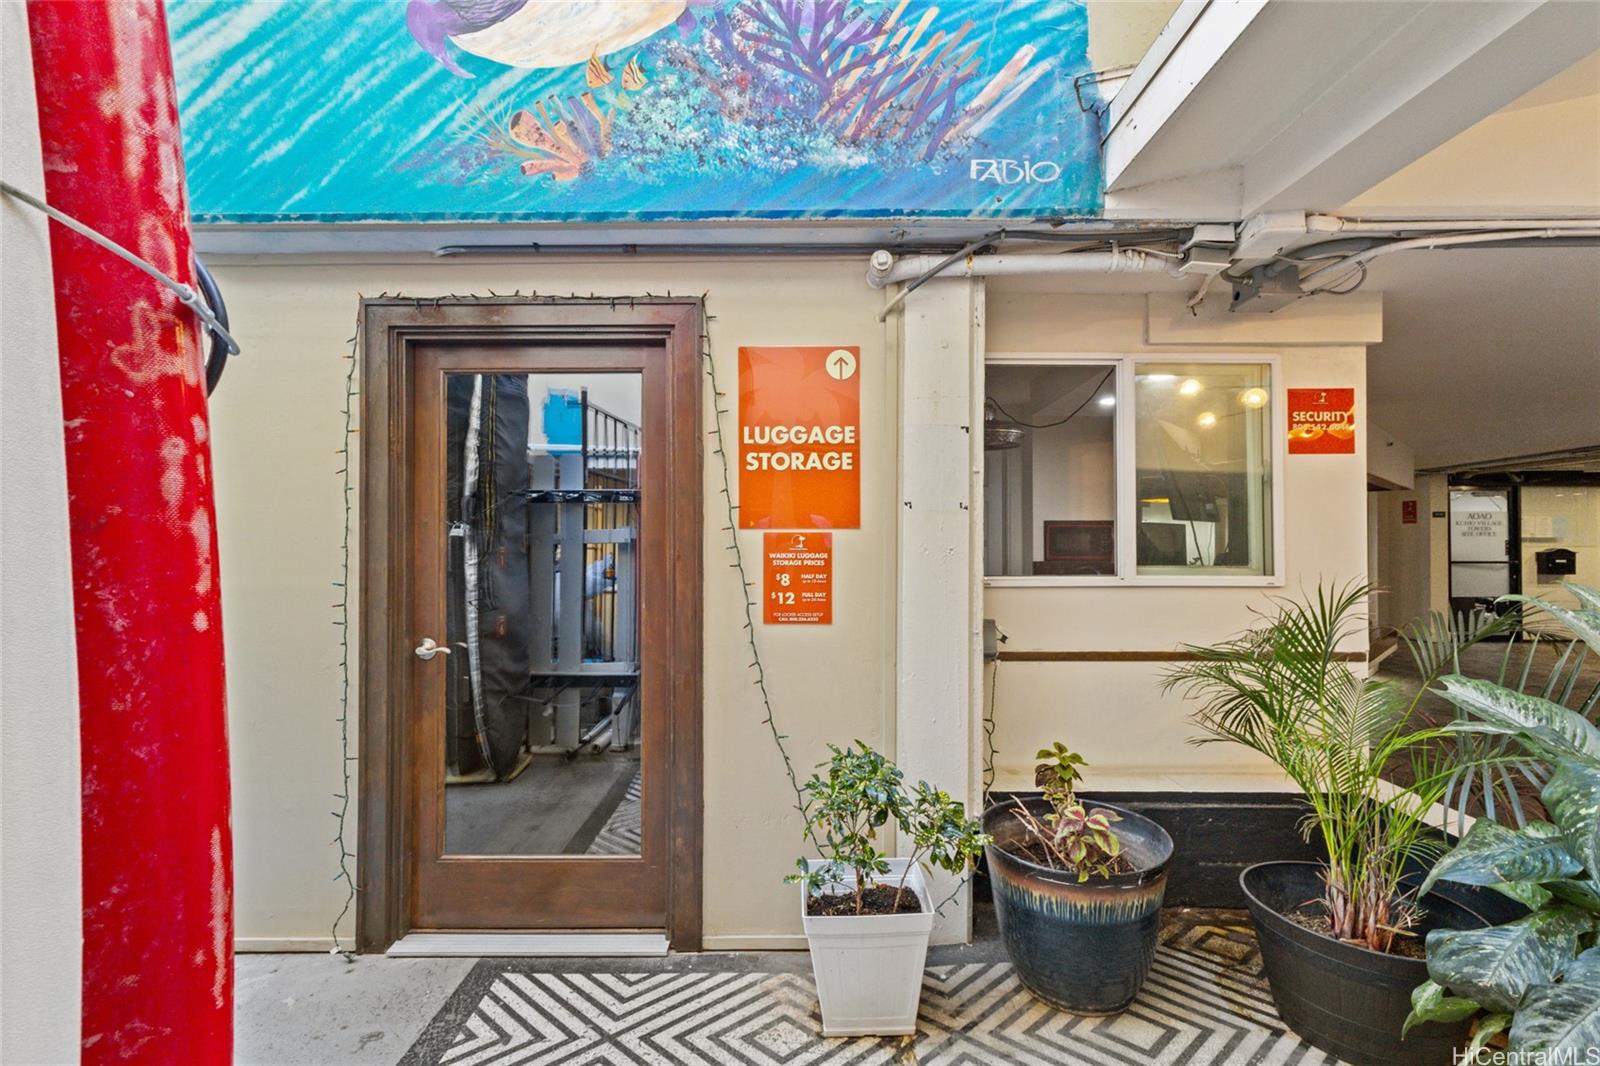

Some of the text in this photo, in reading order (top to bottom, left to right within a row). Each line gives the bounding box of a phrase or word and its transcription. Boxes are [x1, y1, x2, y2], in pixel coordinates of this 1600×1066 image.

[1292, 411, 1348, 422] SECURITY
[743, 425, 856, 445] LUGGAGE
[745, 452, 853, 471] STORAGE
[776, 573, 791, 587] $8
[771, 591, 795, 605] $12
